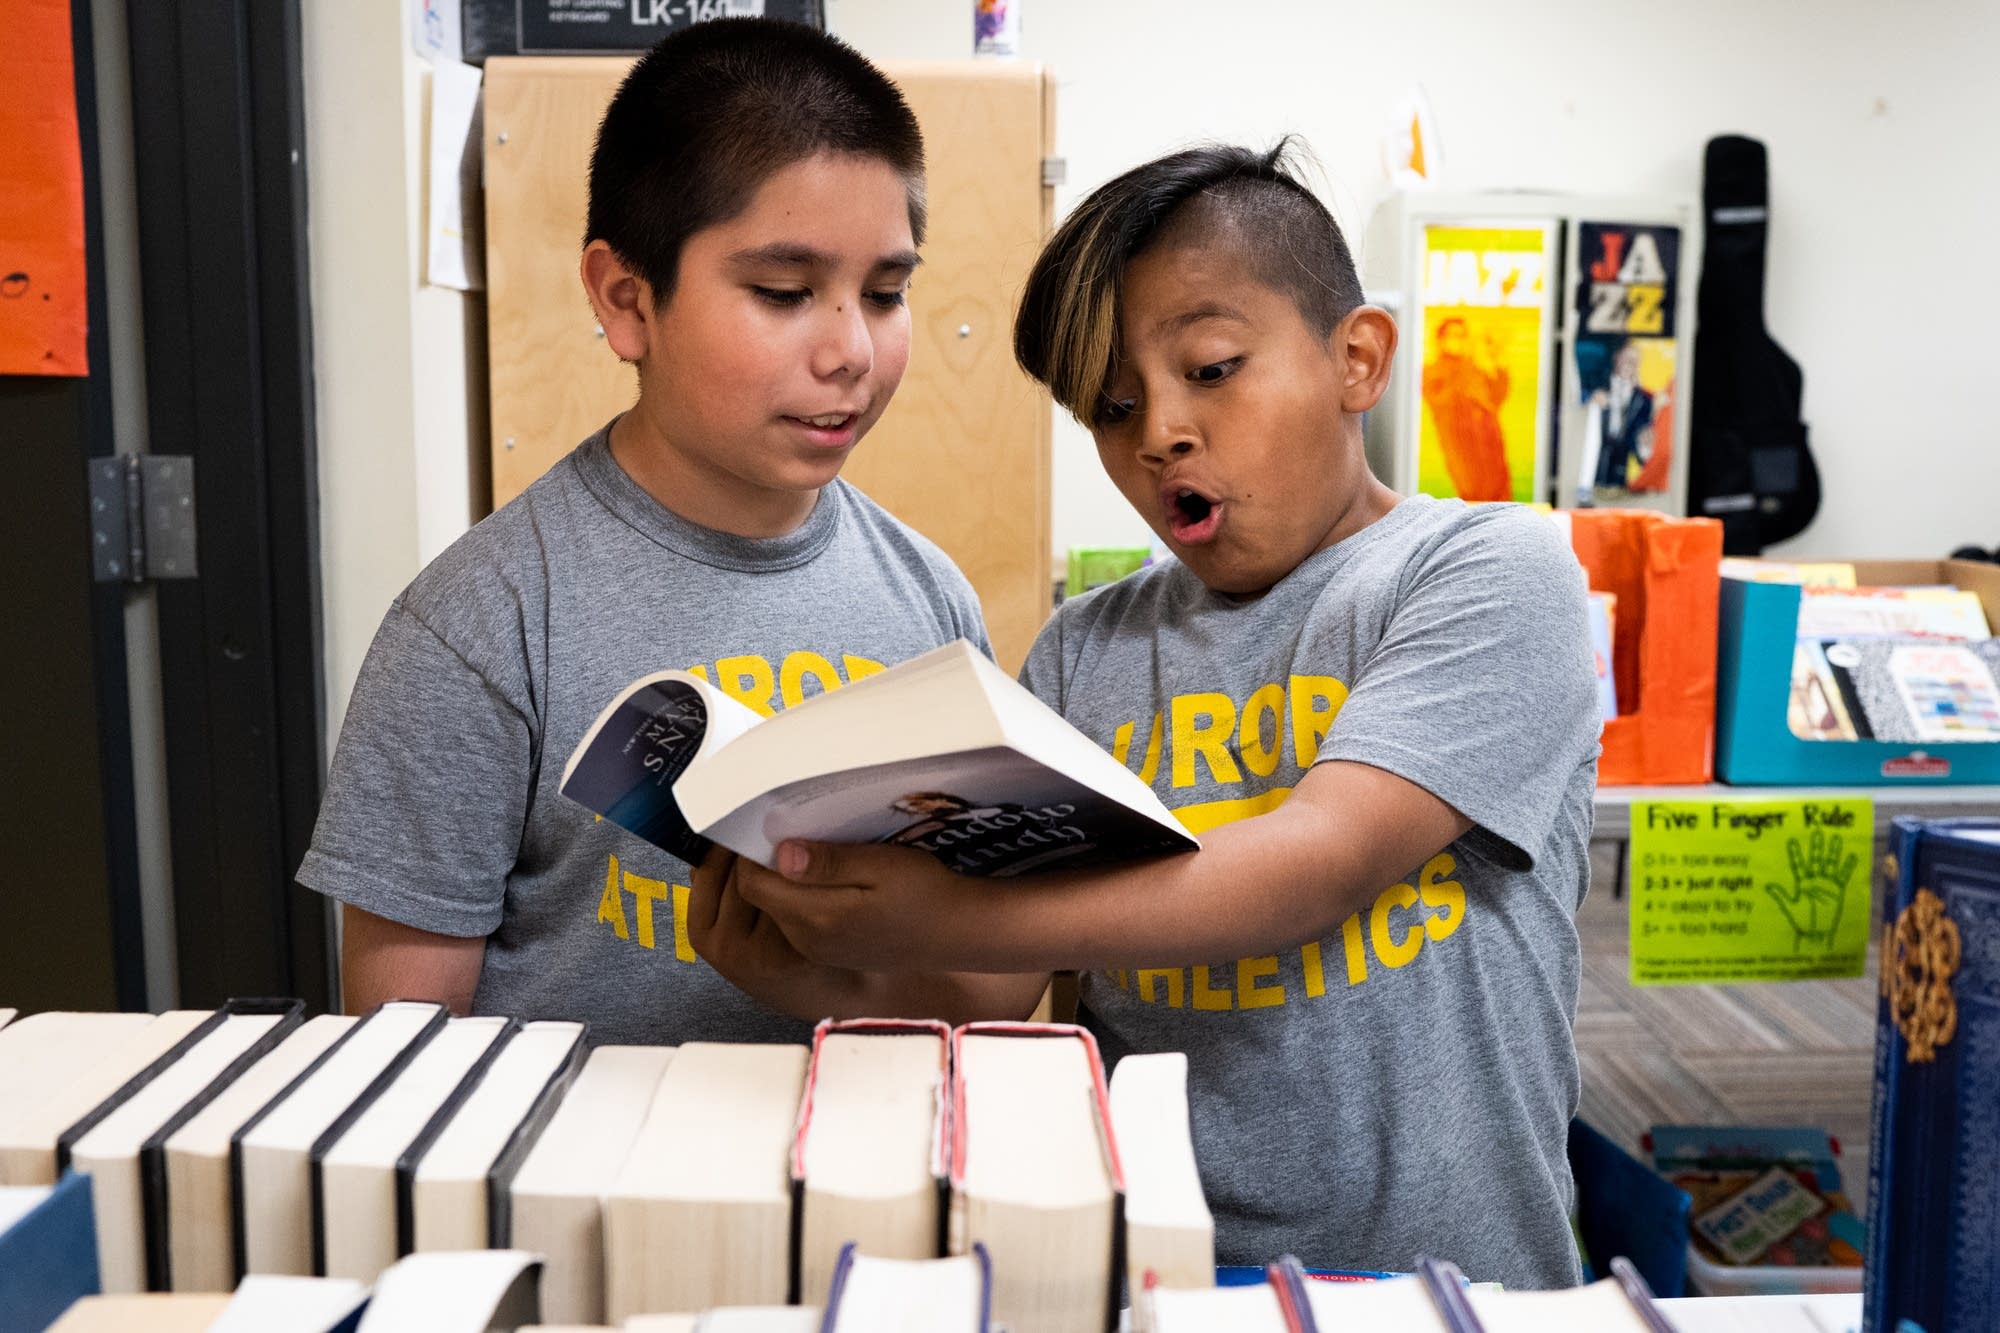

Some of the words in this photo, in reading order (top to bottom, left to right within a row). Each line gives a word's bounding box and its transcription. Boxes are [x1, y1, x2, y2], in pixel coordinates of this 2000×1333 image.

[1427, 250, 1543, 305] JAZZ
[1648, 804, 1697, 829] Five
[1713, 804, 1788, 840] Finger
[1803, 803, 1854, 828] Rule
